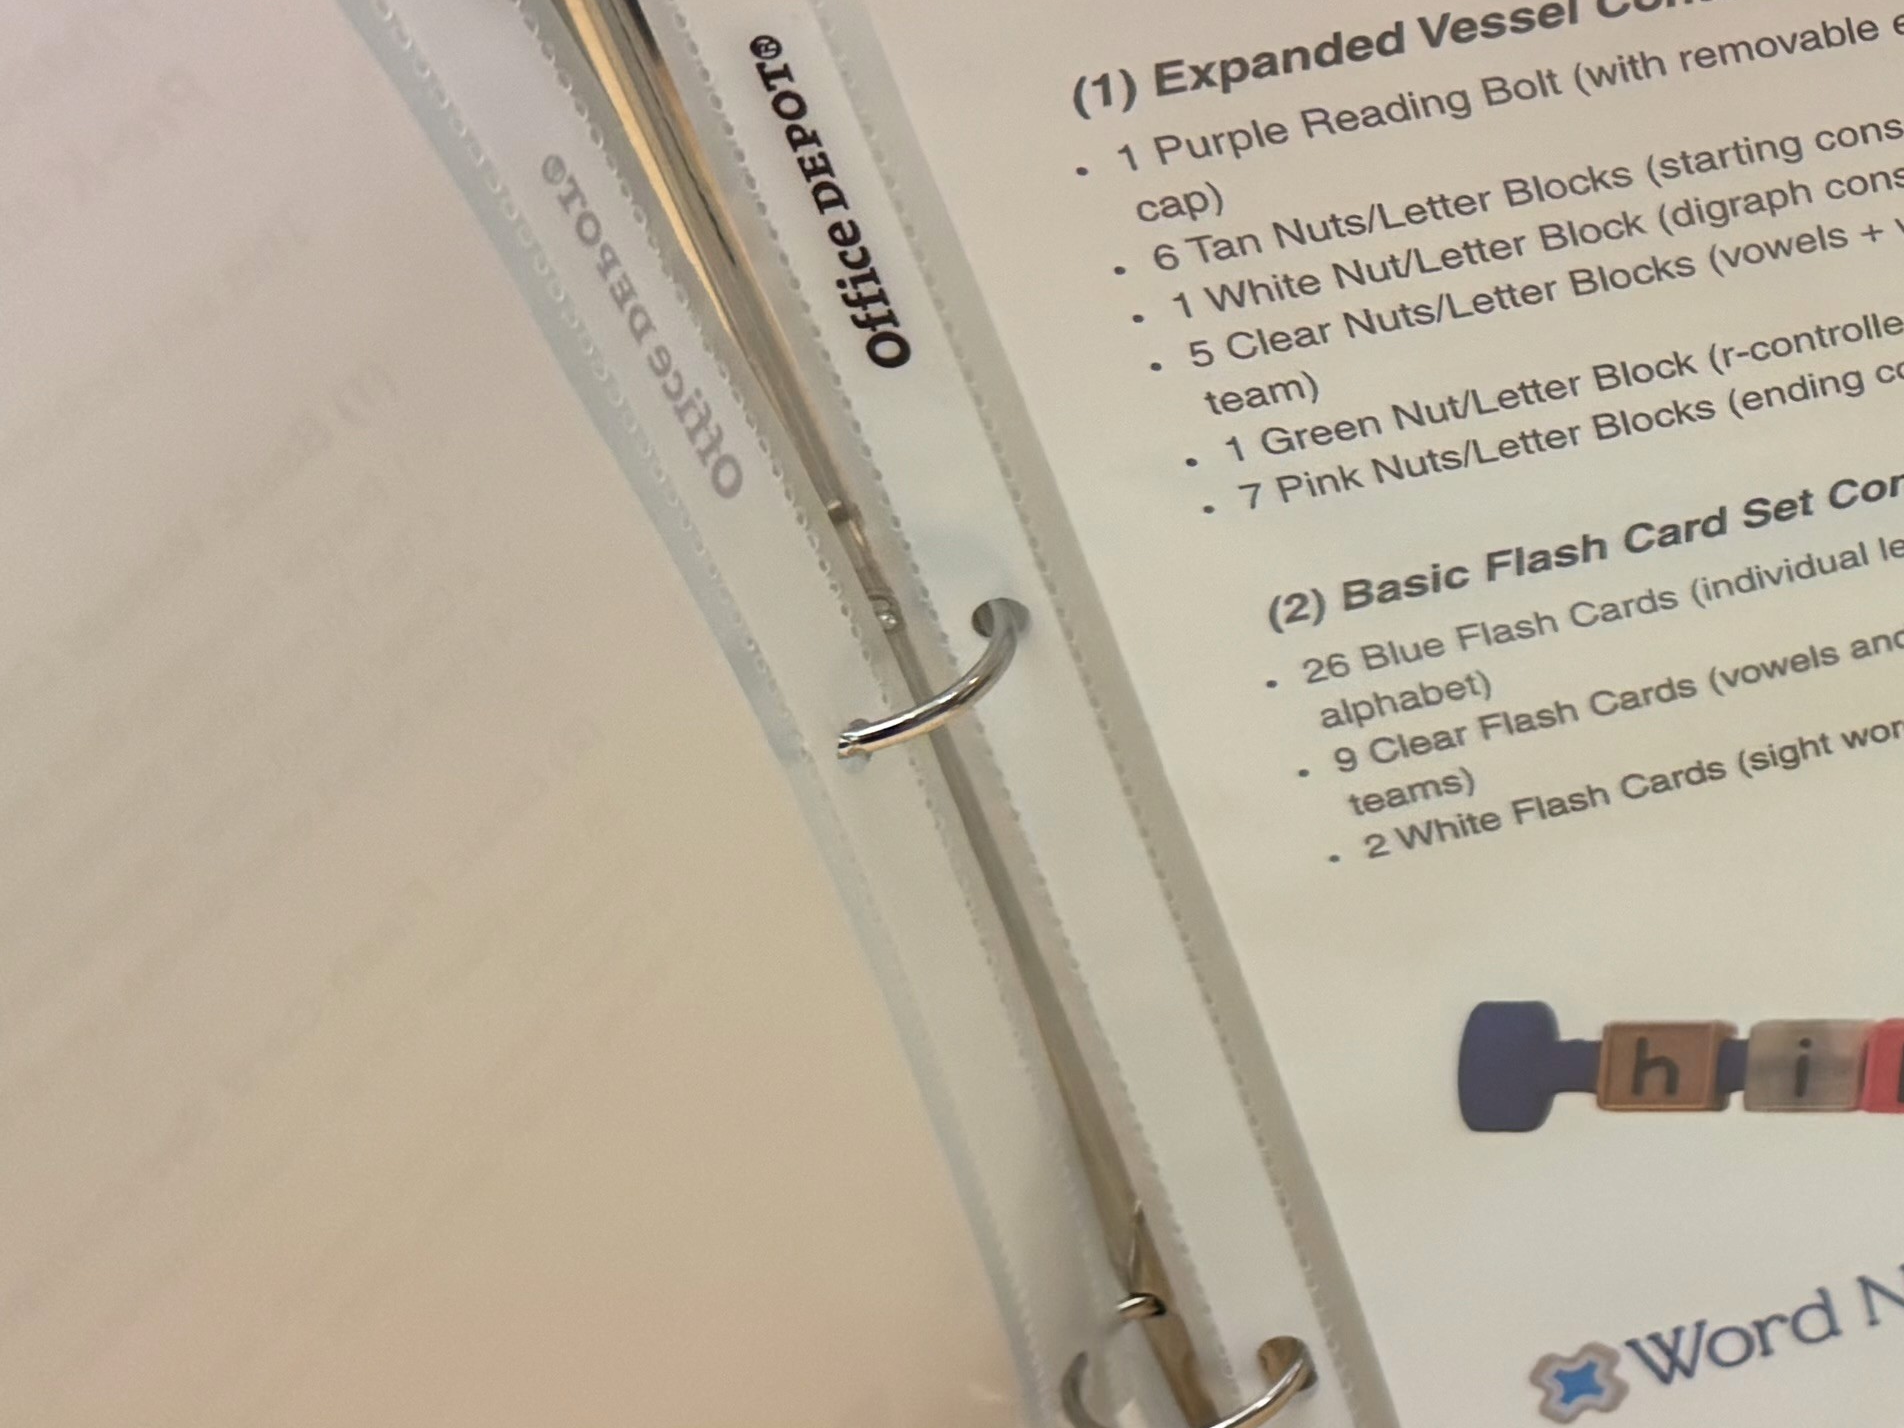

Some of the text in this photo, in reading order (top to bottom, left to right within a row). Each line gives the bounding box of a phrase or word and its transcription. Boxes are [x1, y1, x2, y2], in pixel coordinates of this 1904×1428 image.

[1071, 67, 1138, 121] (1)
[1153, 19, 1406, 98] Expanded
[1116, 143, 1139, 173] 1
[1151, 118, 1290, 167] Purple
[1298, 88, 1473, 140] Reading
[1479, 68, 1564, 108] Bolt
[1572, 50, 1669, 98] (with
[1677, 15, 1881, 74] removable
[1135, 180, 1225, 224] cap)
[1151, 242, 1181, 272] 6
[1182, 232, 1264, 264] Tan
[1271, 189, 1493, 250] Nuts/Letter
[1501, 164, 1635, 208] Blocks
[1645, 134, 1805, 190] (starting
[1171, 290, 1194, 320] 1
[1202, 272, 1323, 314] White
[1330, 234, 1527, 291] Nut/Letter
[1536, 210, 1648, 253] Block
[1657, 178, 1814, 238] (digraph
[827, 218, 912, 370] Office
[1267, 586, 1327, 635] (2)
[1341, 562, 1471, 613] Basic
[1484, 532, 1609, 583] Flash
[1622, 504, 1729, 555] Card
[1742, 487, 1815, 530] Set
[1300, 651, 1352, 686] 26
[1358, 636, 1447, 672] Blue
[1454, 610, 1560, 652] Flash
[1567, 587, 1680, 629] Cards
[1689, 540, 1871, 610] (individual
[1319, 668, 1493, 731] alphabet)
[1362, 832, 1392, 861] 2
[1392, 810, 1503, 851] White
[1509, 783, 1612, 826] Flash
[1618, 758, 1728, 801] Cards
[1736, 731, 1835, 780] (sight
[1622, 1285, 1844, 1388] Word
